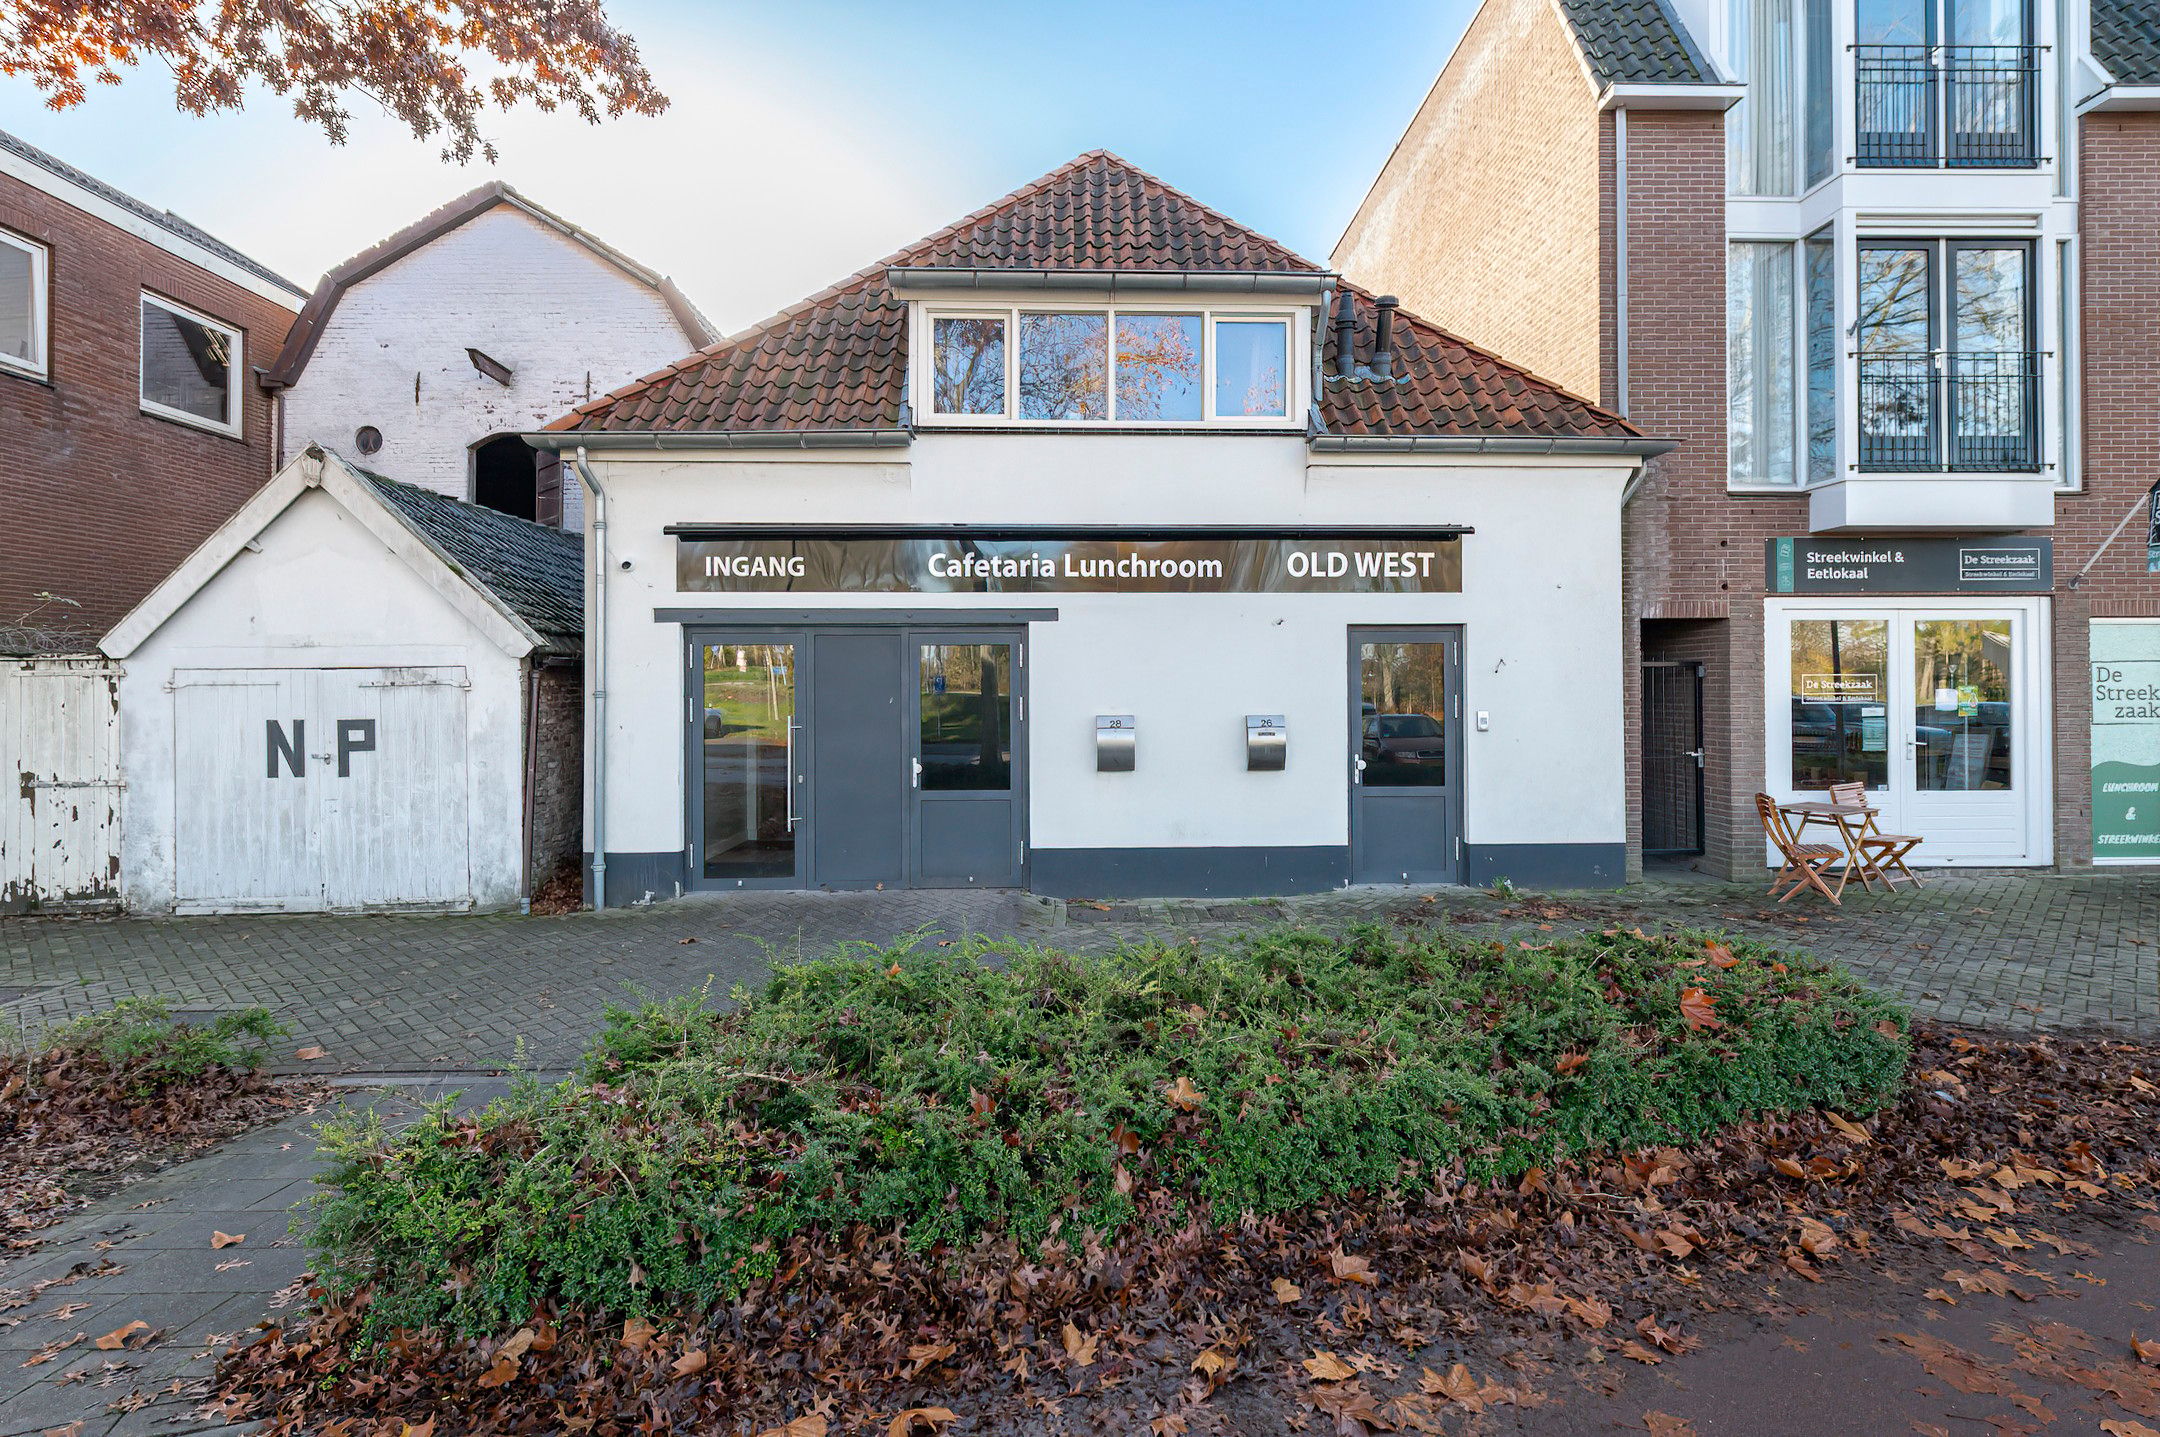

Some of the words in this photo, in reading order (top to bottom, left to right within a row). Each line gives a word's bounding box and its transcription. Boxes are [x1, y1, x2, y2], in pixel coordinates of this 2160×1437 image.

[1806, 550, 1892, 563] Streekwinkel
[1894, 551, 1905, 563] &
[1964, 555, 1979, 564] De
[1980, 554, 2036, 564] Streekzaak
[705, 556, 805, 577] INGANG
[928, 552, 1056, 578] Cafetaria
[1064, 552, 1223, 578] Lunchroom
[1287, 551, 1349, 578] OLD
[1354, 552, 1435, 578] WEST
[1807, 567, 1869, 579] Eetlokaal
[2096, 666, 2123, 683] De
[1806, 680, 1819, 689] De
[1821, 680, 1873, 689] Streekzaak
[2096, 684, 2160, 701] Streek
[2114, 701, 2160, 719] zaak
[1109, 720, 1122, 729] 28
[1260, 719, 1273, 728] 26
[2125, 806, 2137, 821] &
